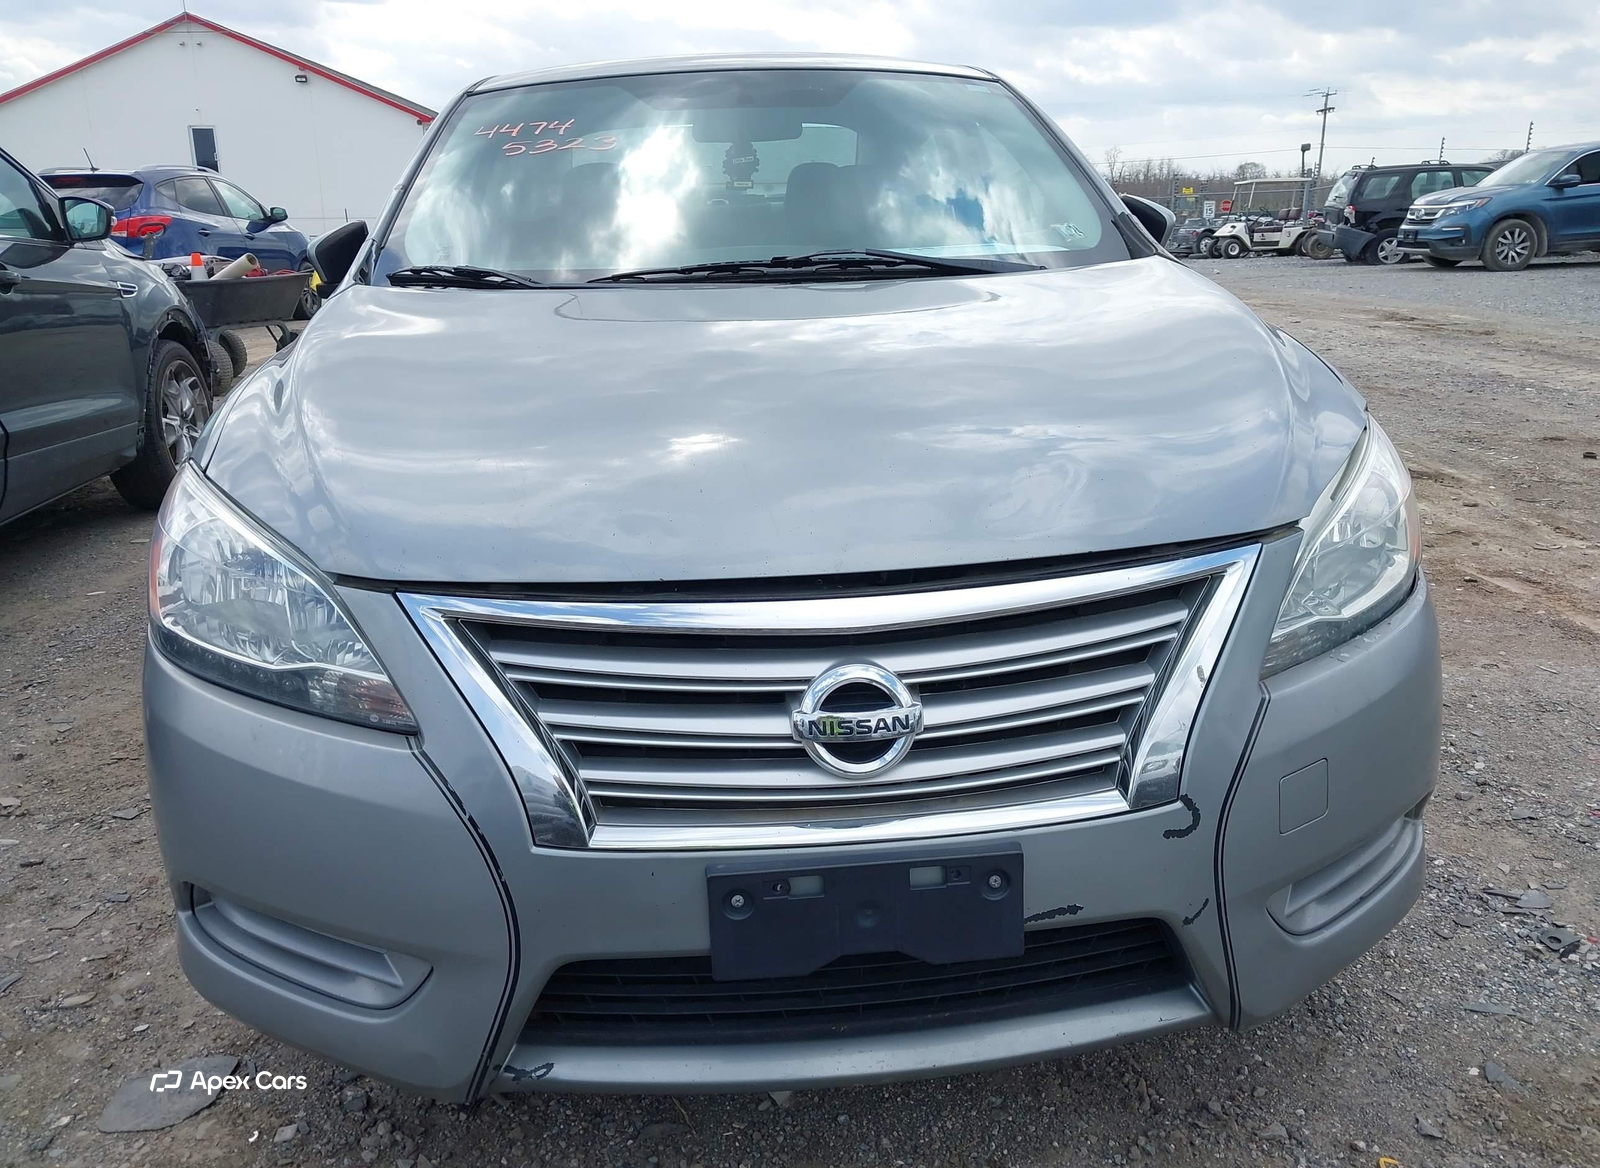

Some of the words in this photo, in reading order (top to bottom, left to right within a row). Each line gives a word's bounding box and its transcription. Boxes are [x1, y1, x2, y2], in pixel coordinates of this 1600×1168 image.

[474, 118, 575, 139] 4474
[502, 136, 617, 156] 5323
[808, 714, 910, 736] NISSAN
